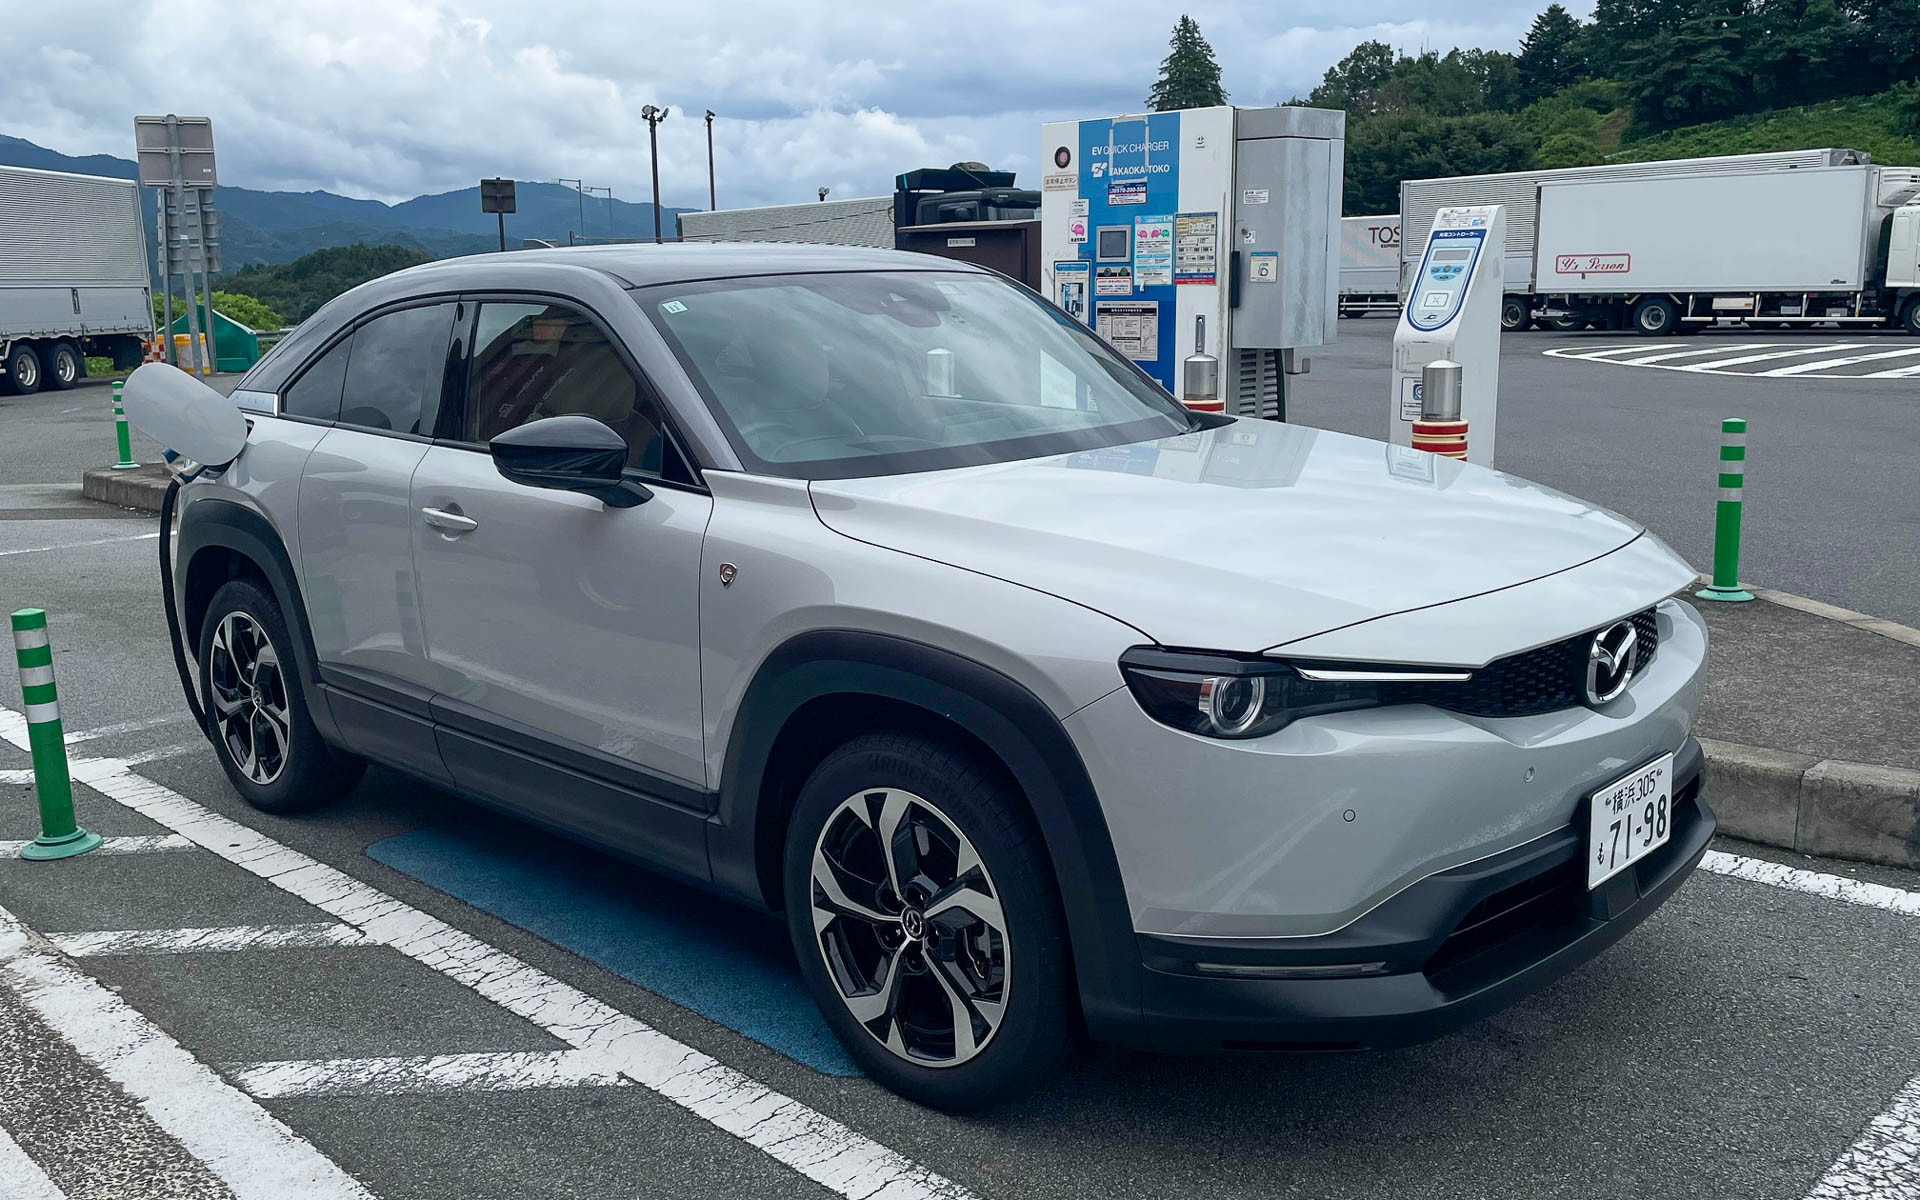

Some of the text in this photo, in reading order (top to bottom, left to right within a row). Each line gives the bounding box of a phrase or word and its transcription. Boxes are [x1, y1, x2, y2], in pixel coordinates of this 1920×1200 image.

[1092, 146, 1103, 156] EV
[1129, 141, 1169, 153] CHARGER
[1147, 164, 1170, 174] TOKO
[1585, 256, 1625, 270] Person
[1597, 794, 1667, 870] も 71-98
